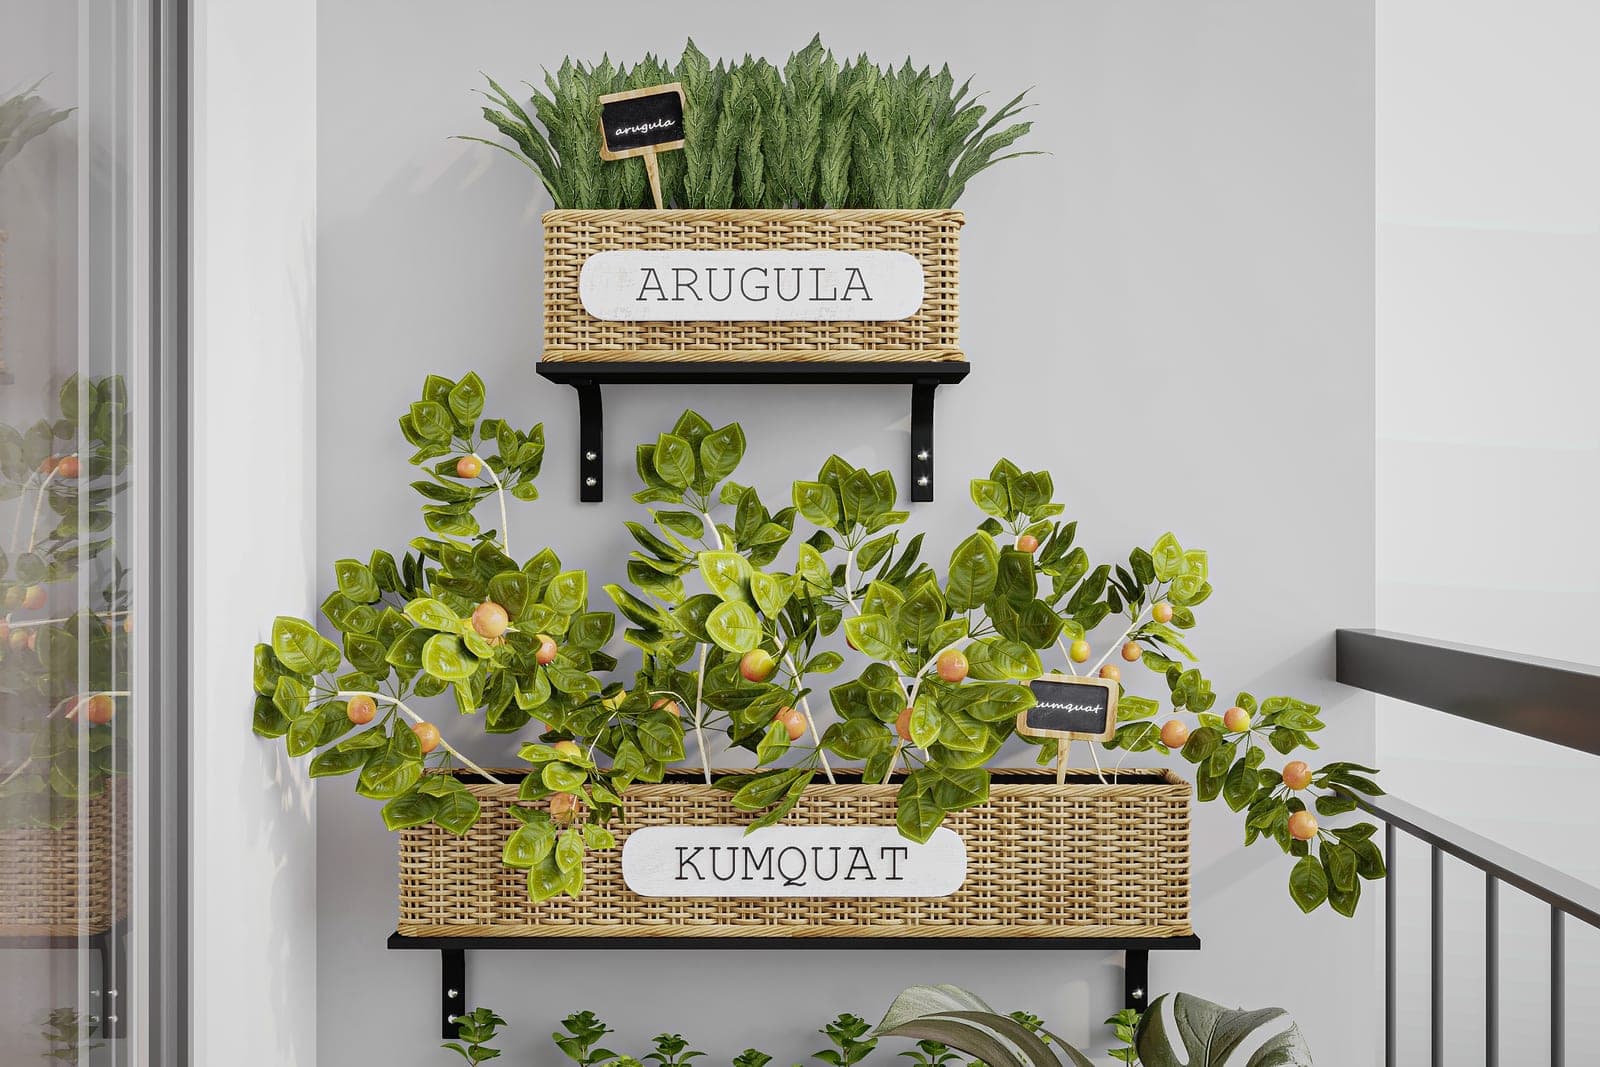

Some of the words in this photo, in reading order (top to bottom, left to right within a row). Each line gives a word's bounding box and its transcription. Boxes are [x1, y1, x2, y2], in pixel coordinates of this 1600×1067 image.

[615, 118, 675, 135] arugula
[636, 267, 873, 301] ARUGULA
[1035, 701, 1104, 714] umquat
[675, 846, 908, 887] KUMQUAT
